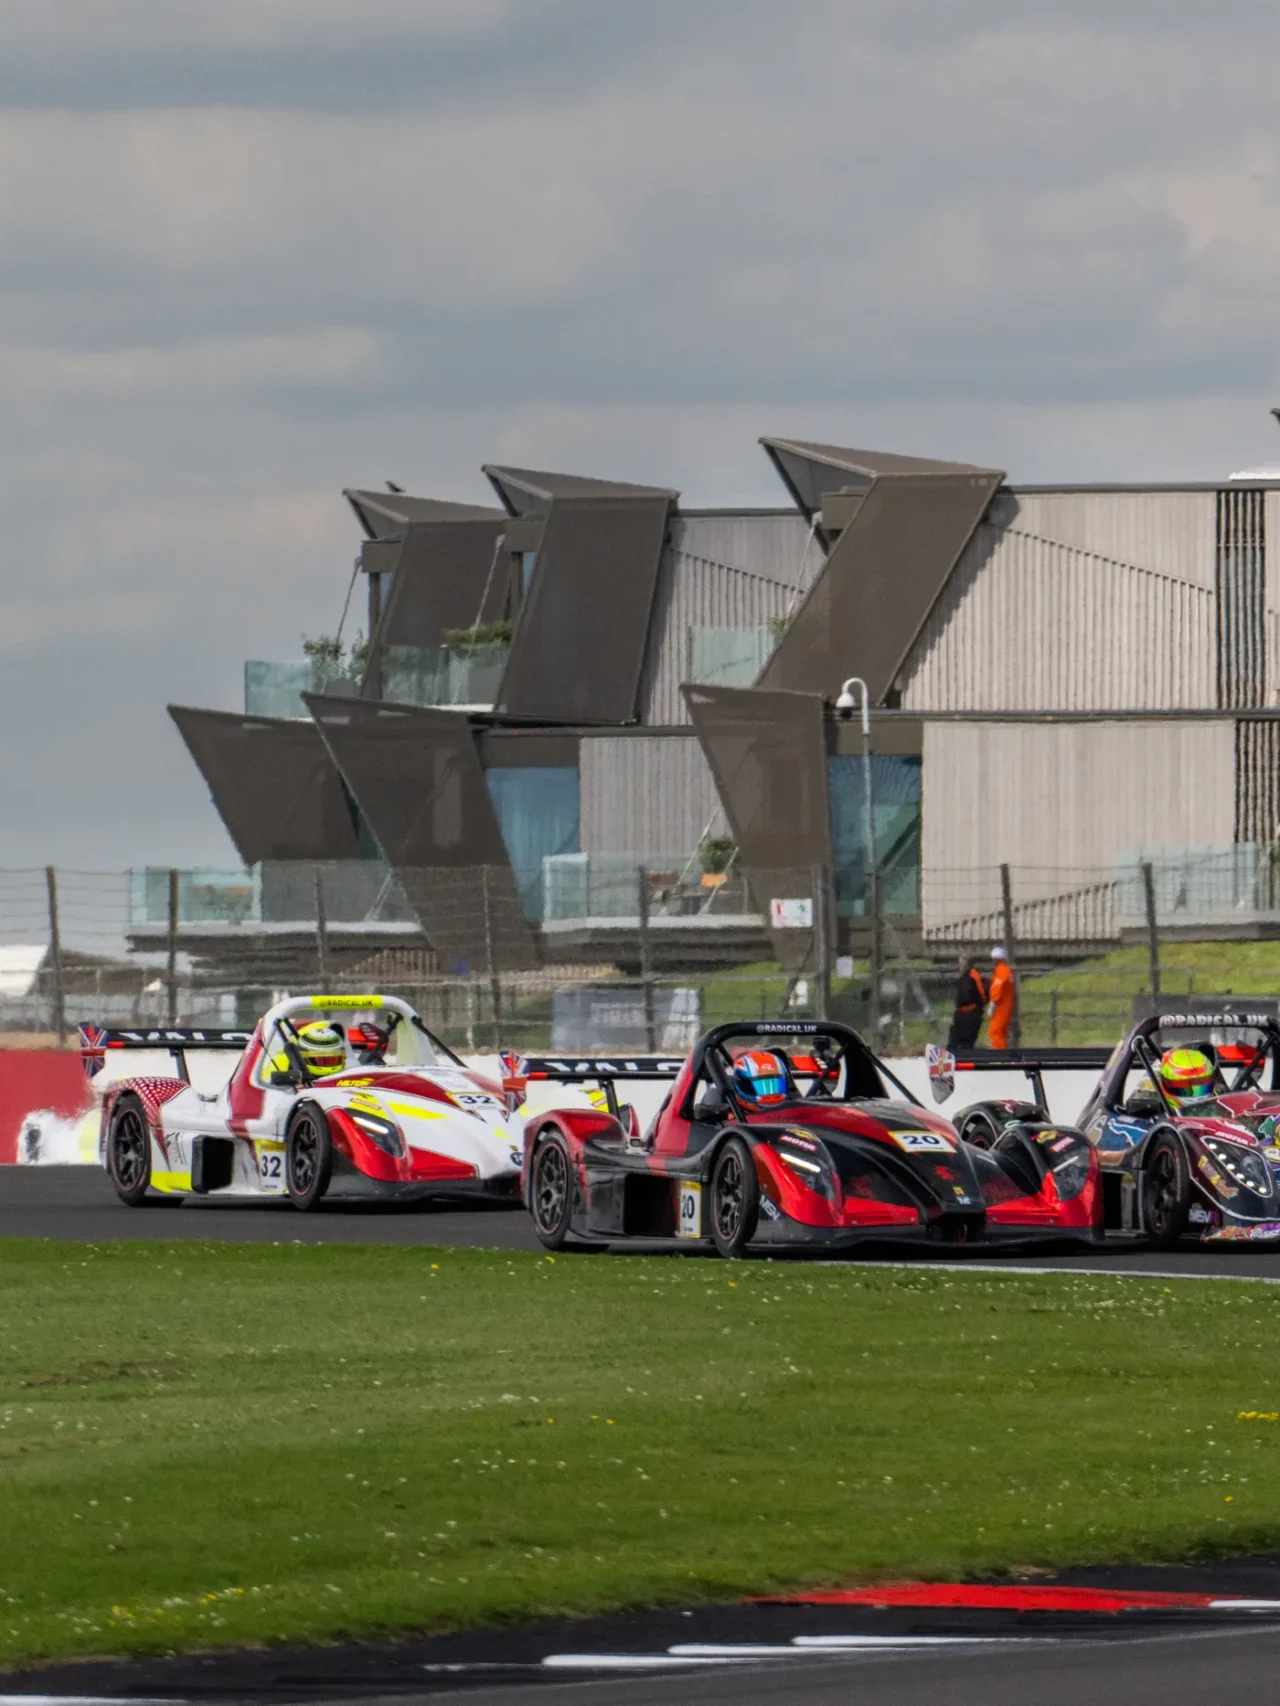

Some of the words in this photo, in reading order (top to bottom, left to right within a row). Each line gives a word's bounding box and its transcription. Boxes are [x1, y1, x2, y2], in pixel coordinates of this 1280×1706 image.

[756, 1024, 817, 1033] @RADICAL.UK
[459, 1095, 495, 1105] 32
[903, 1135, 941, 1145] 20
[260, 1155, 281, 1177] 32
[682, 1194, 695, 1219] 20
